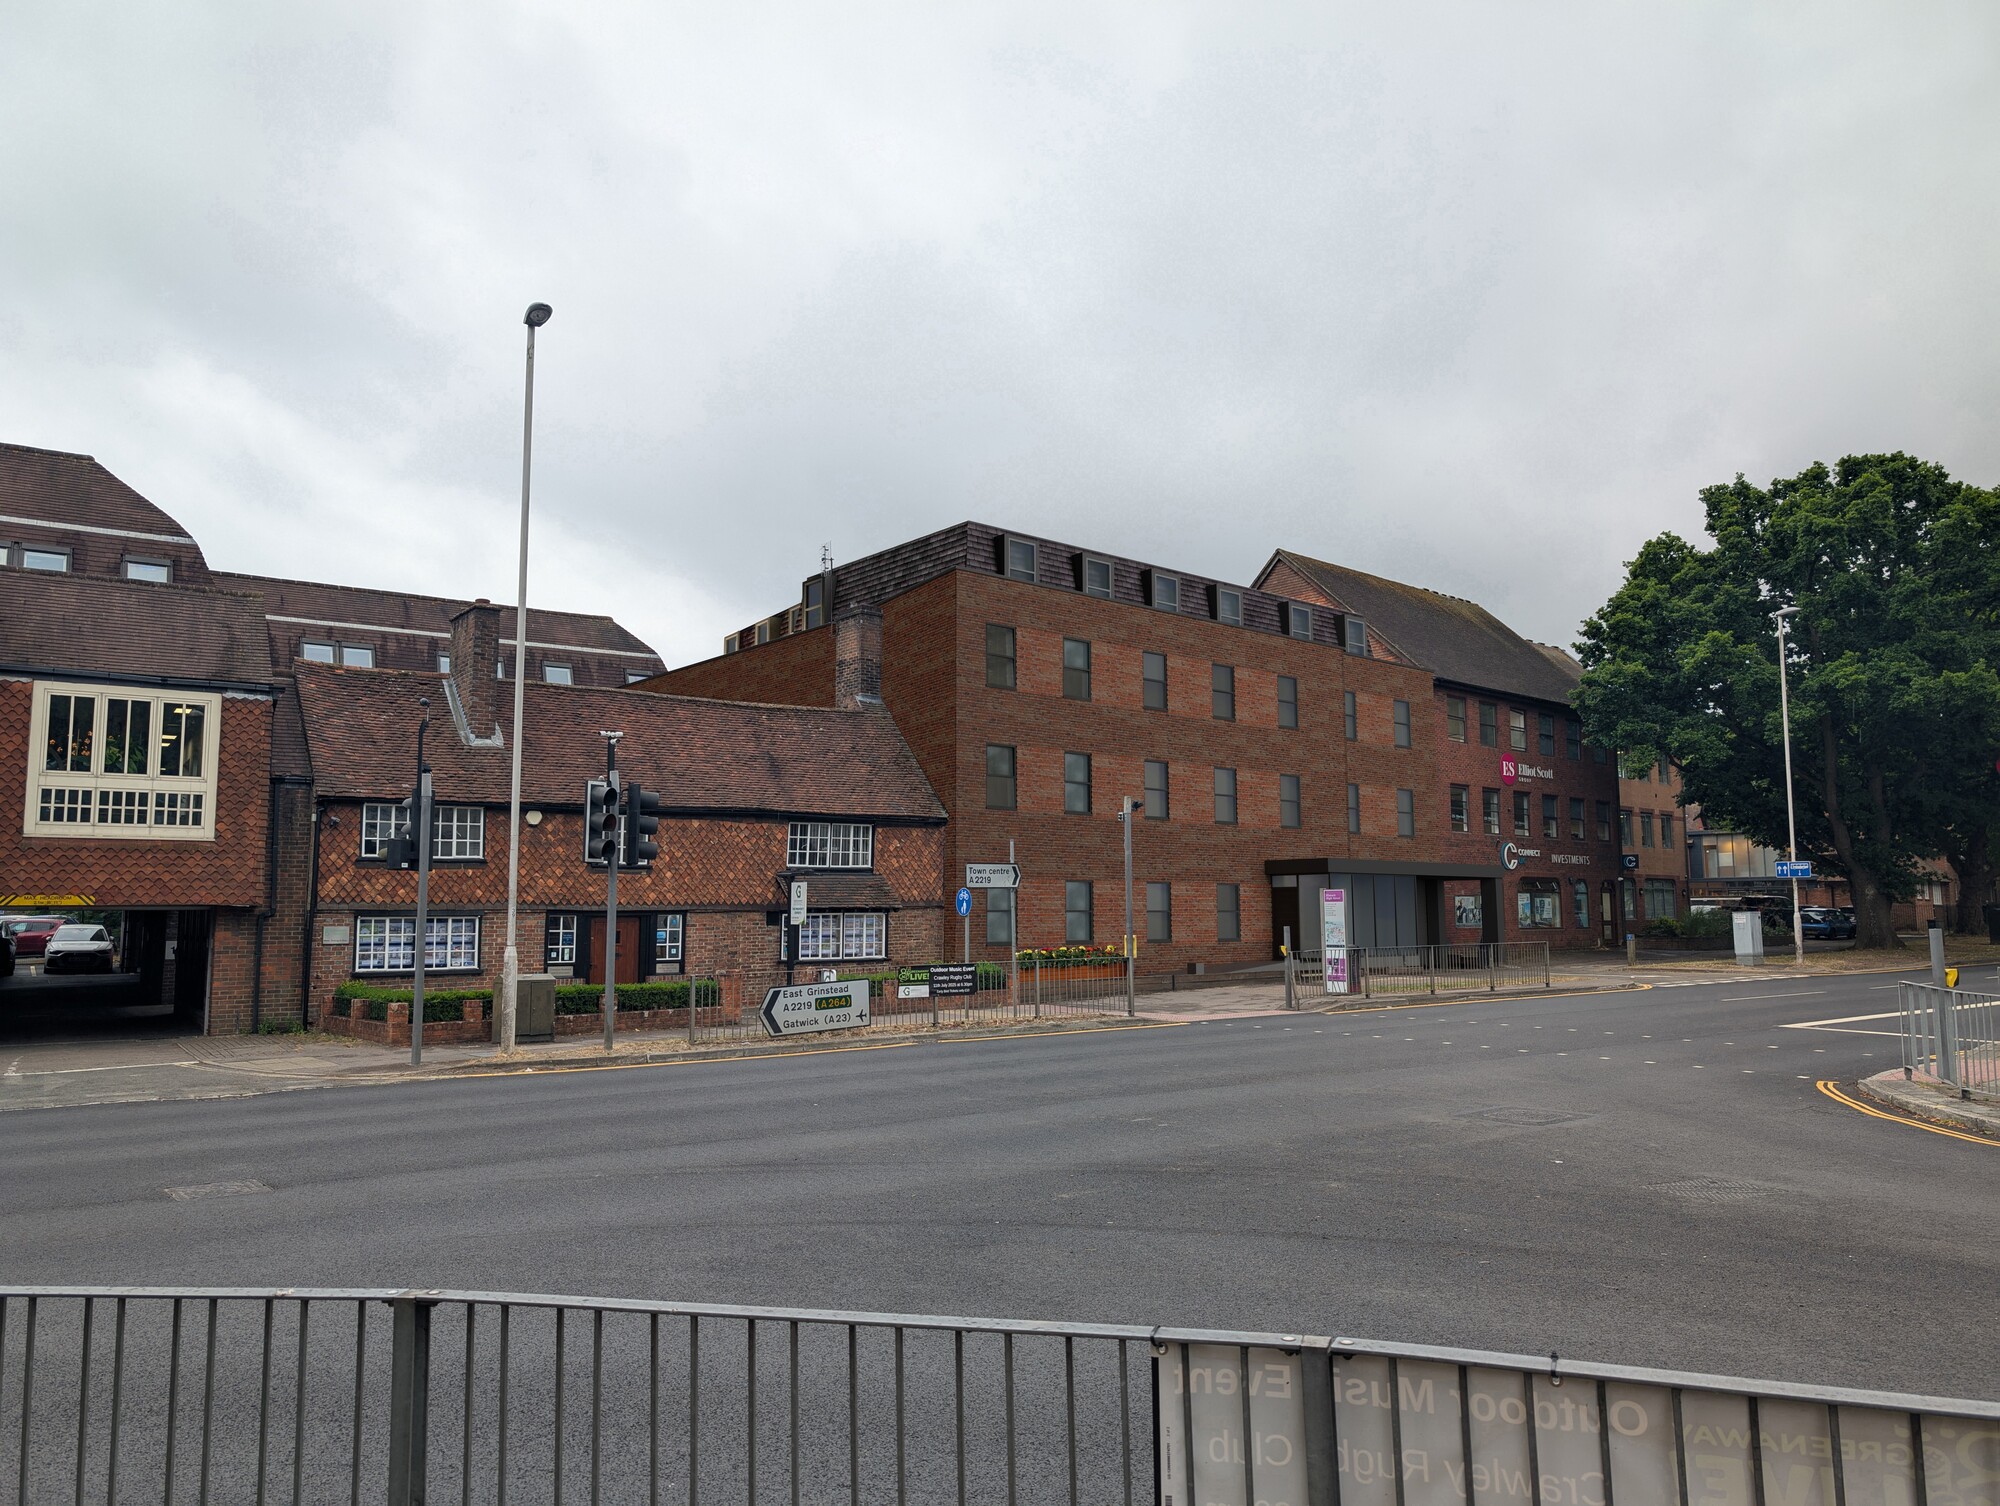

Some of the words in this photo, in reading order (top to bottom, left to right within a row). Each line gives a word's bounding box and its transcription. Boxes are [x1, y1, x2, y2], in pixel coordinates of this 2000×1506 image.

[1502, 761, 1515, 777] ES
[1518, 763, 1536, 777] Elliot
[1537, 766, 1554, 779] Scott
[1518, 848, 1541, 857] CONNECT
[1551, 854, 1591, 865] INVESTMENTS
[968, 866, 987, 875] Town
[989, 866, 1010, 875] centre
[968, 876, 991, 884] A2219
[783, 989, 803, 999] East
[807, 984, 849, 996] Grinstead
[783, 1000, 812, 1012] A2219
[816, 997, 851, 1010] (A264)
[783, 1017, 819, 1029] Gatwick
[824, 1012, 851, 1024] (A23)
